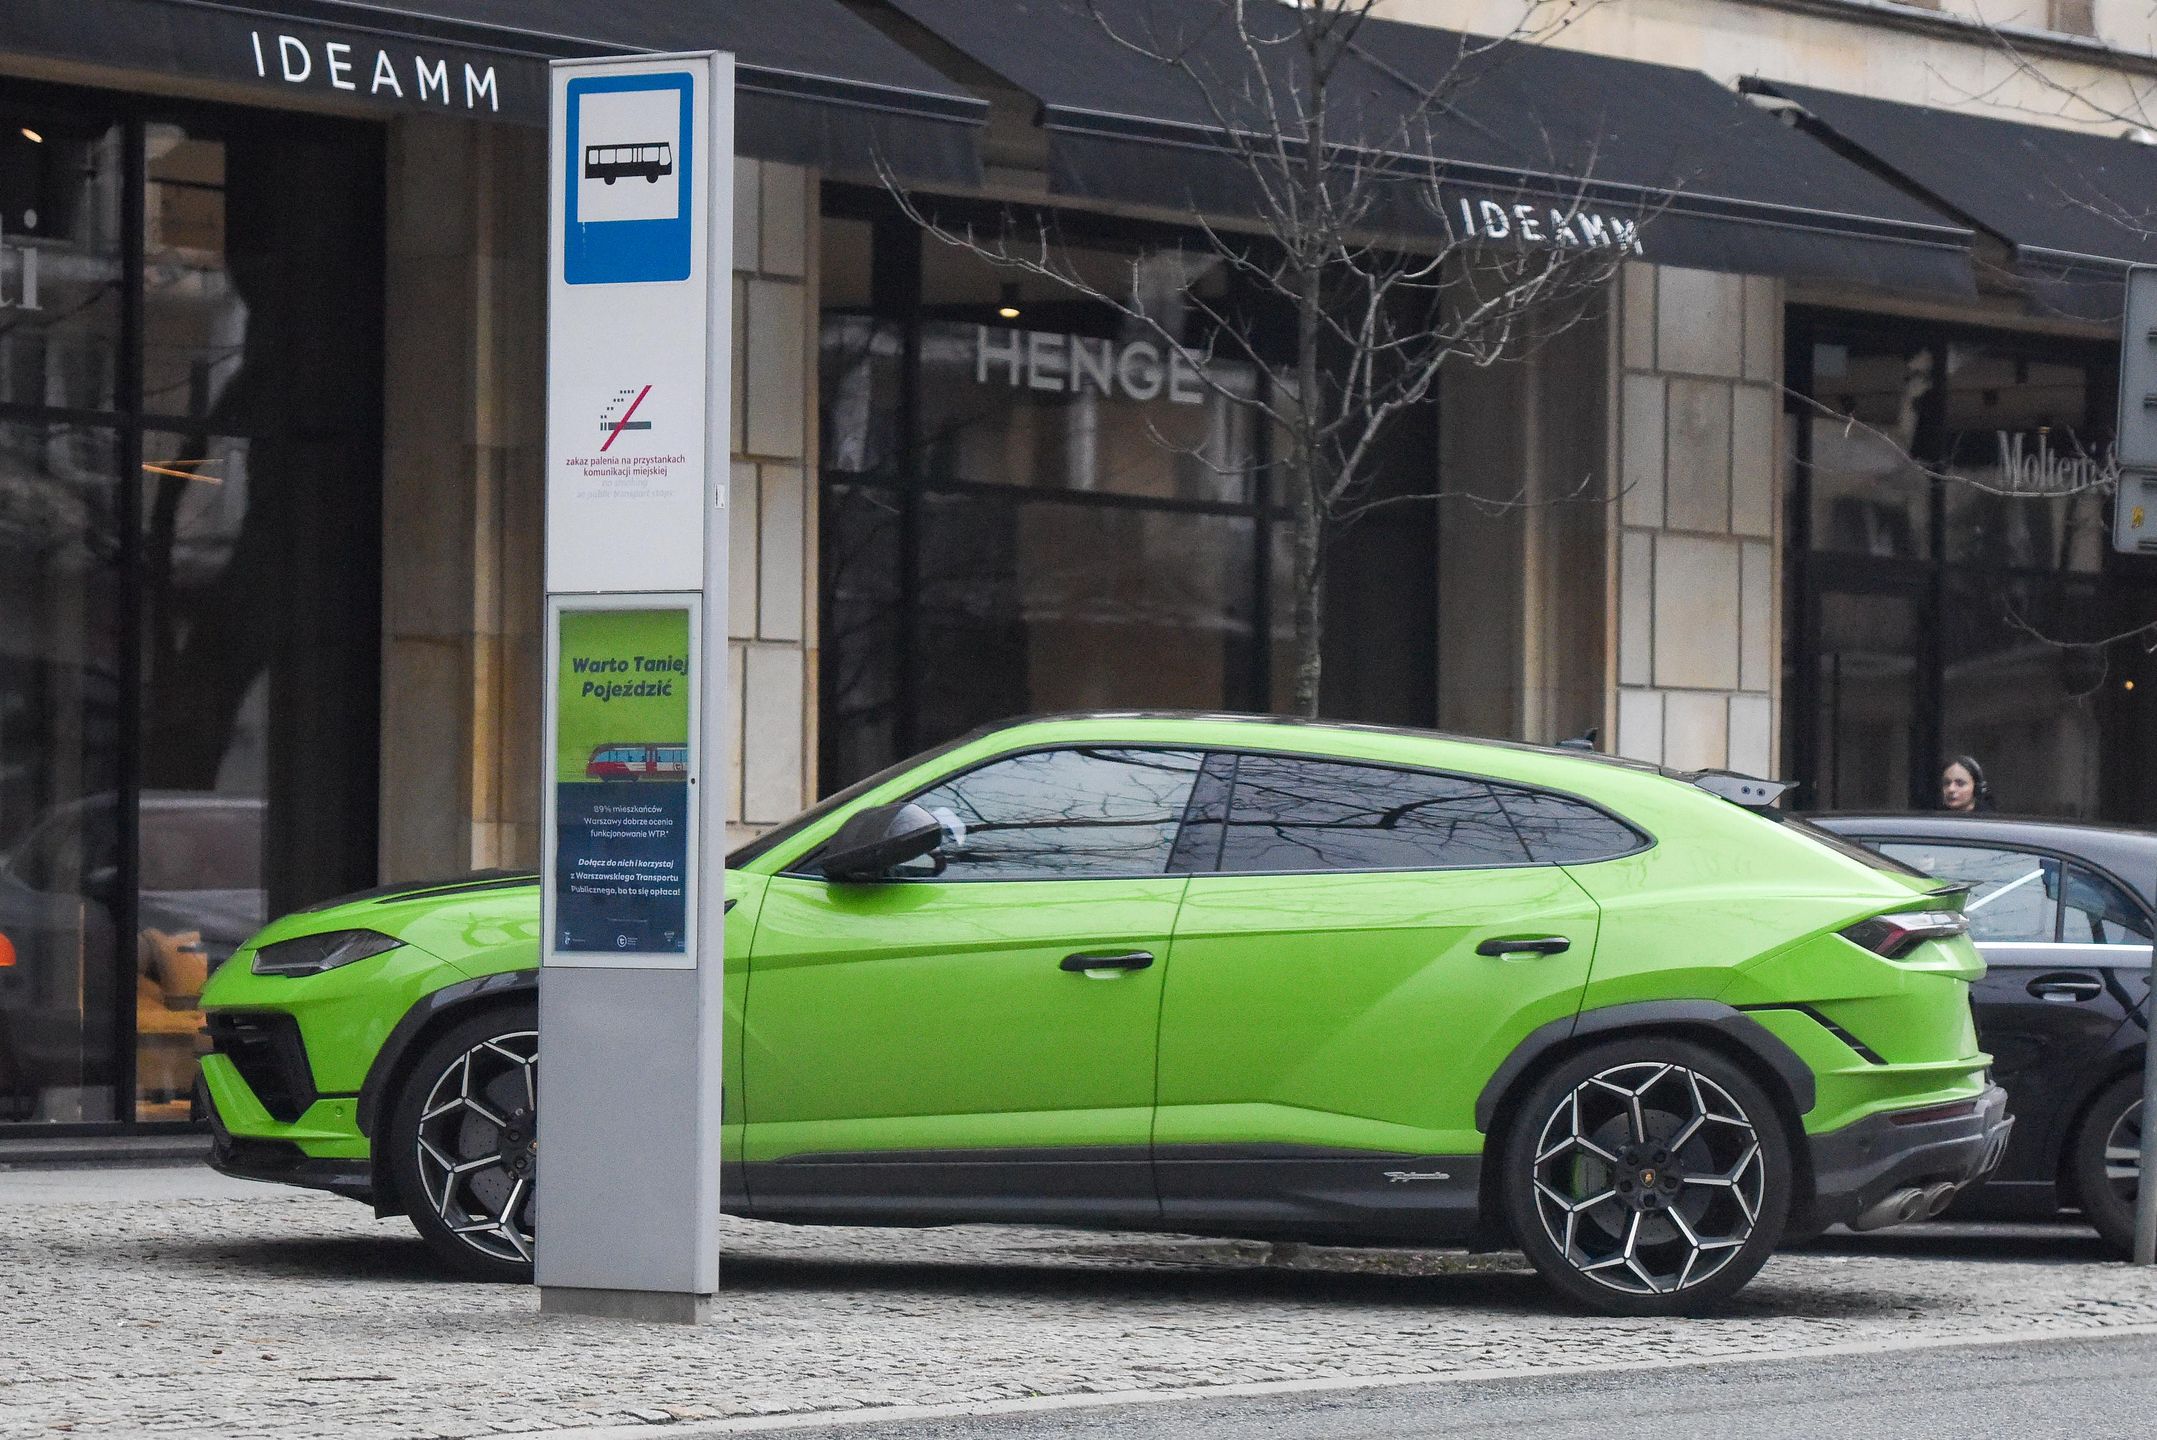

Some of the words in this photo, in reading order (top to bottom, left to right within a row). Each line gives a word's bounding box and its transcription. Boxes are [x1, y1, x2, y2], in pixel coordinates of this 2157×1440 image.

[251, 31, 499, 112] IDEAMM
[1460, 198, 1644, 256] IDEAMM
[976, 325, 1205, 405] HENGE
[566, 457, 588, 466] zakaz
[590, 456, 619, 466] palenia
[621, 457, 632, 465] na
[633, 454, 686, 466] przystankach
[583, 467, 631, 477] komunikacji
[633, 466, 668, 477] miejskiej
[573, 657, 629, 673] Warto
[634, 654, 688, 676] Taniej
[582, 679, 672, 702] Pojeździć
[593, 805, 612, 813] 89%
[613, 804, 663, 813] mieszkańców
[584, 817, 621, 827] Warszawy
[623, 817, 648, 825] dobrze
[649, 818, 673, 826] ocenia
[590, 829, 647, 839] funkcjonowanie
[578, 858, 606, 868] Dołącz
[618, 859, 636, 867] nich
[639, 859, 675, 869] korzystaj
[576, 872, 635, 882] Warszawskiego
[636, 873, 679, 882] Transportu
[571, 885, 618, 896] Publicznego,
[628, 887, 638, 895] to
[638, 887, 648, 896] się
[649, 888, 681, 897] opłaca!
